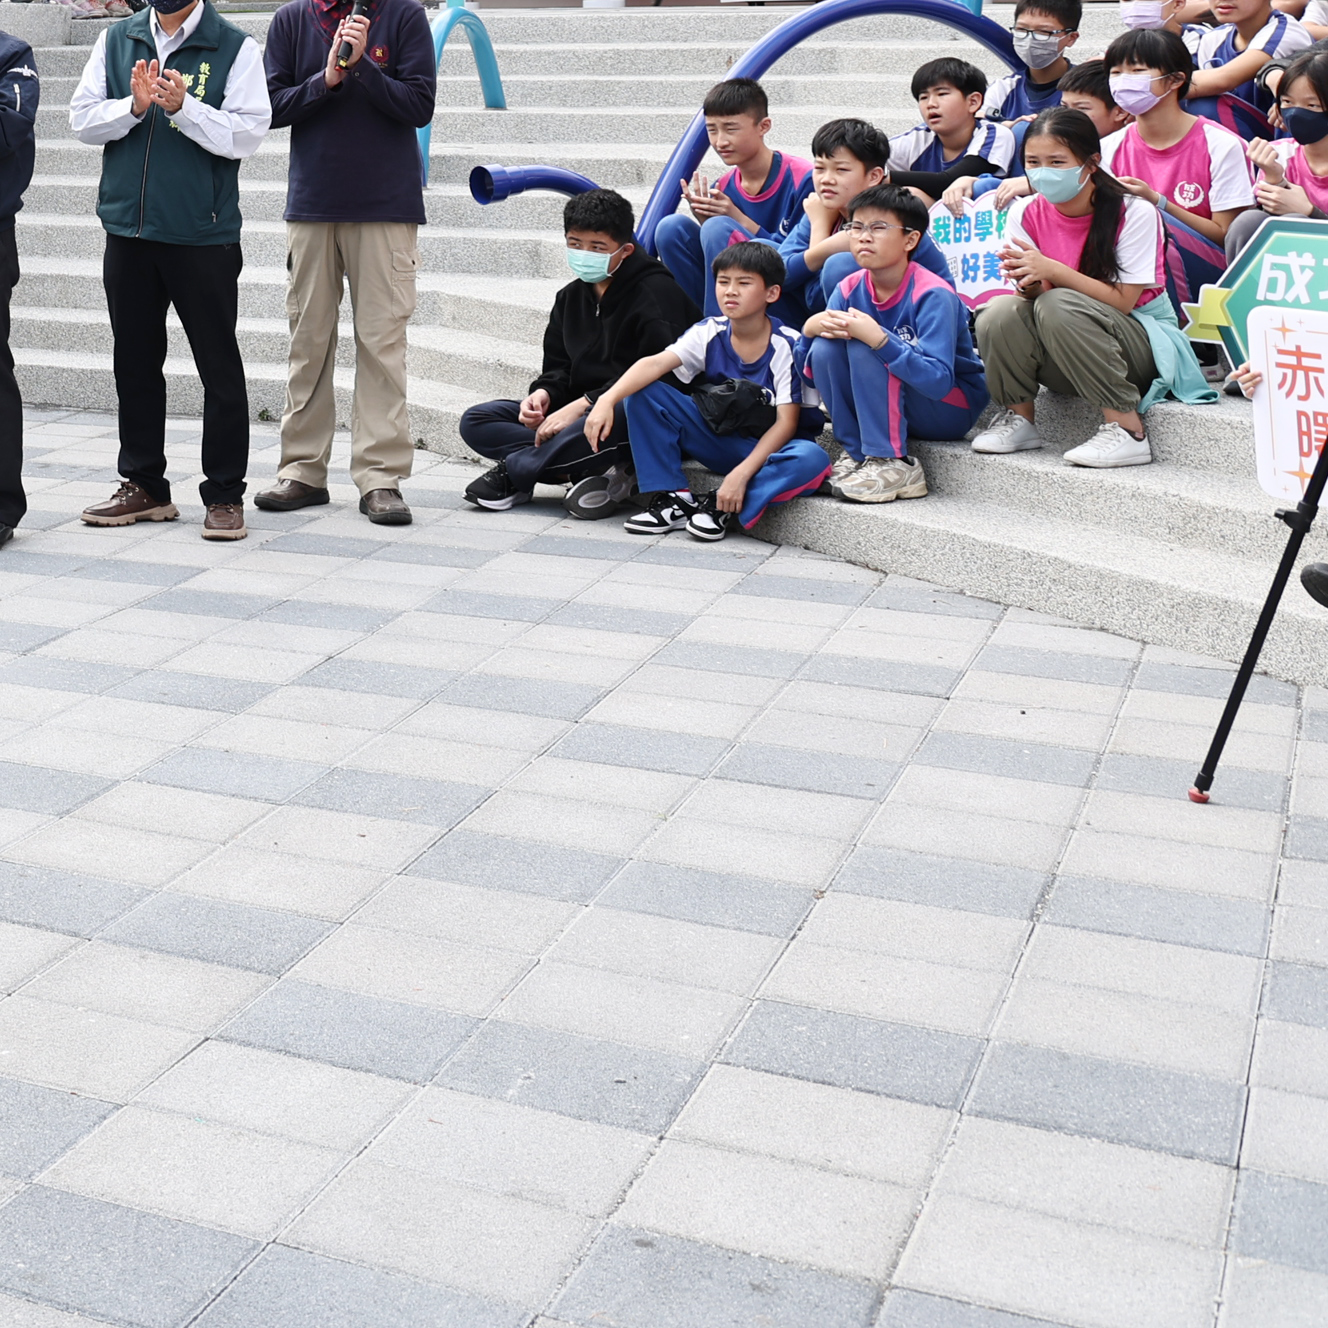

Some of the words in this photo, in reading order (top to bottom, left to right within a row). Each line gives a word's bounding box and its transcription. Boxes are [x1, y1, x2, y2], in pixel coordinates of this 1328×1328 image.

[961, 250, 1003, 283] 好美
[1256, 251, 1328, 305] 成
[1275, 344, 1325, 402] 赤
